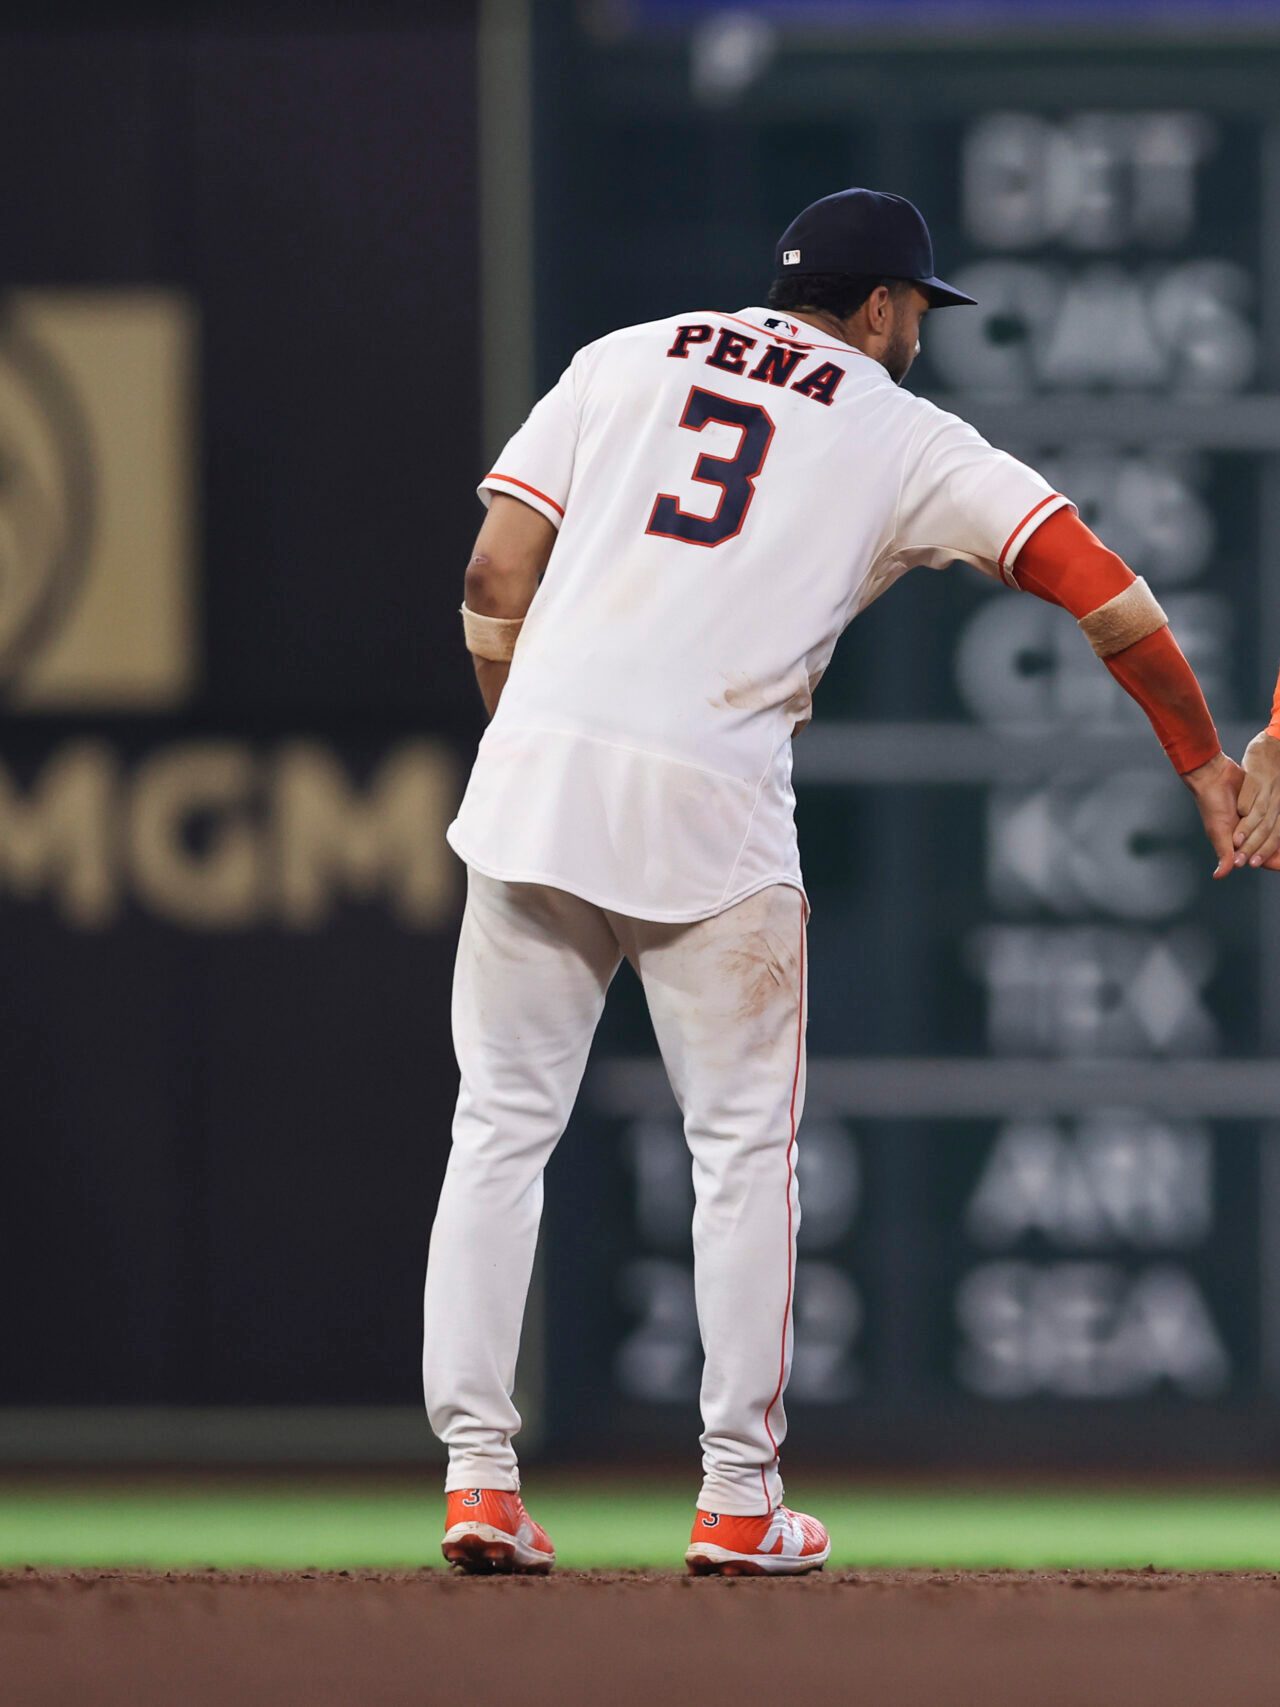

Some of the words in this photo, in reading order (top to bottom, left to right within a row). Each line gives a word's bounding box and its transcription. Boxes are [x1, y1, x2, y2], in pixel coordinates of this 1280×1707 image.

[667, 325, 846, 406] PEÑA
[645, 385, 776, 548] 3
[0, 740, 458, 926] MGM
[986, 766, 1204, 920] KC
